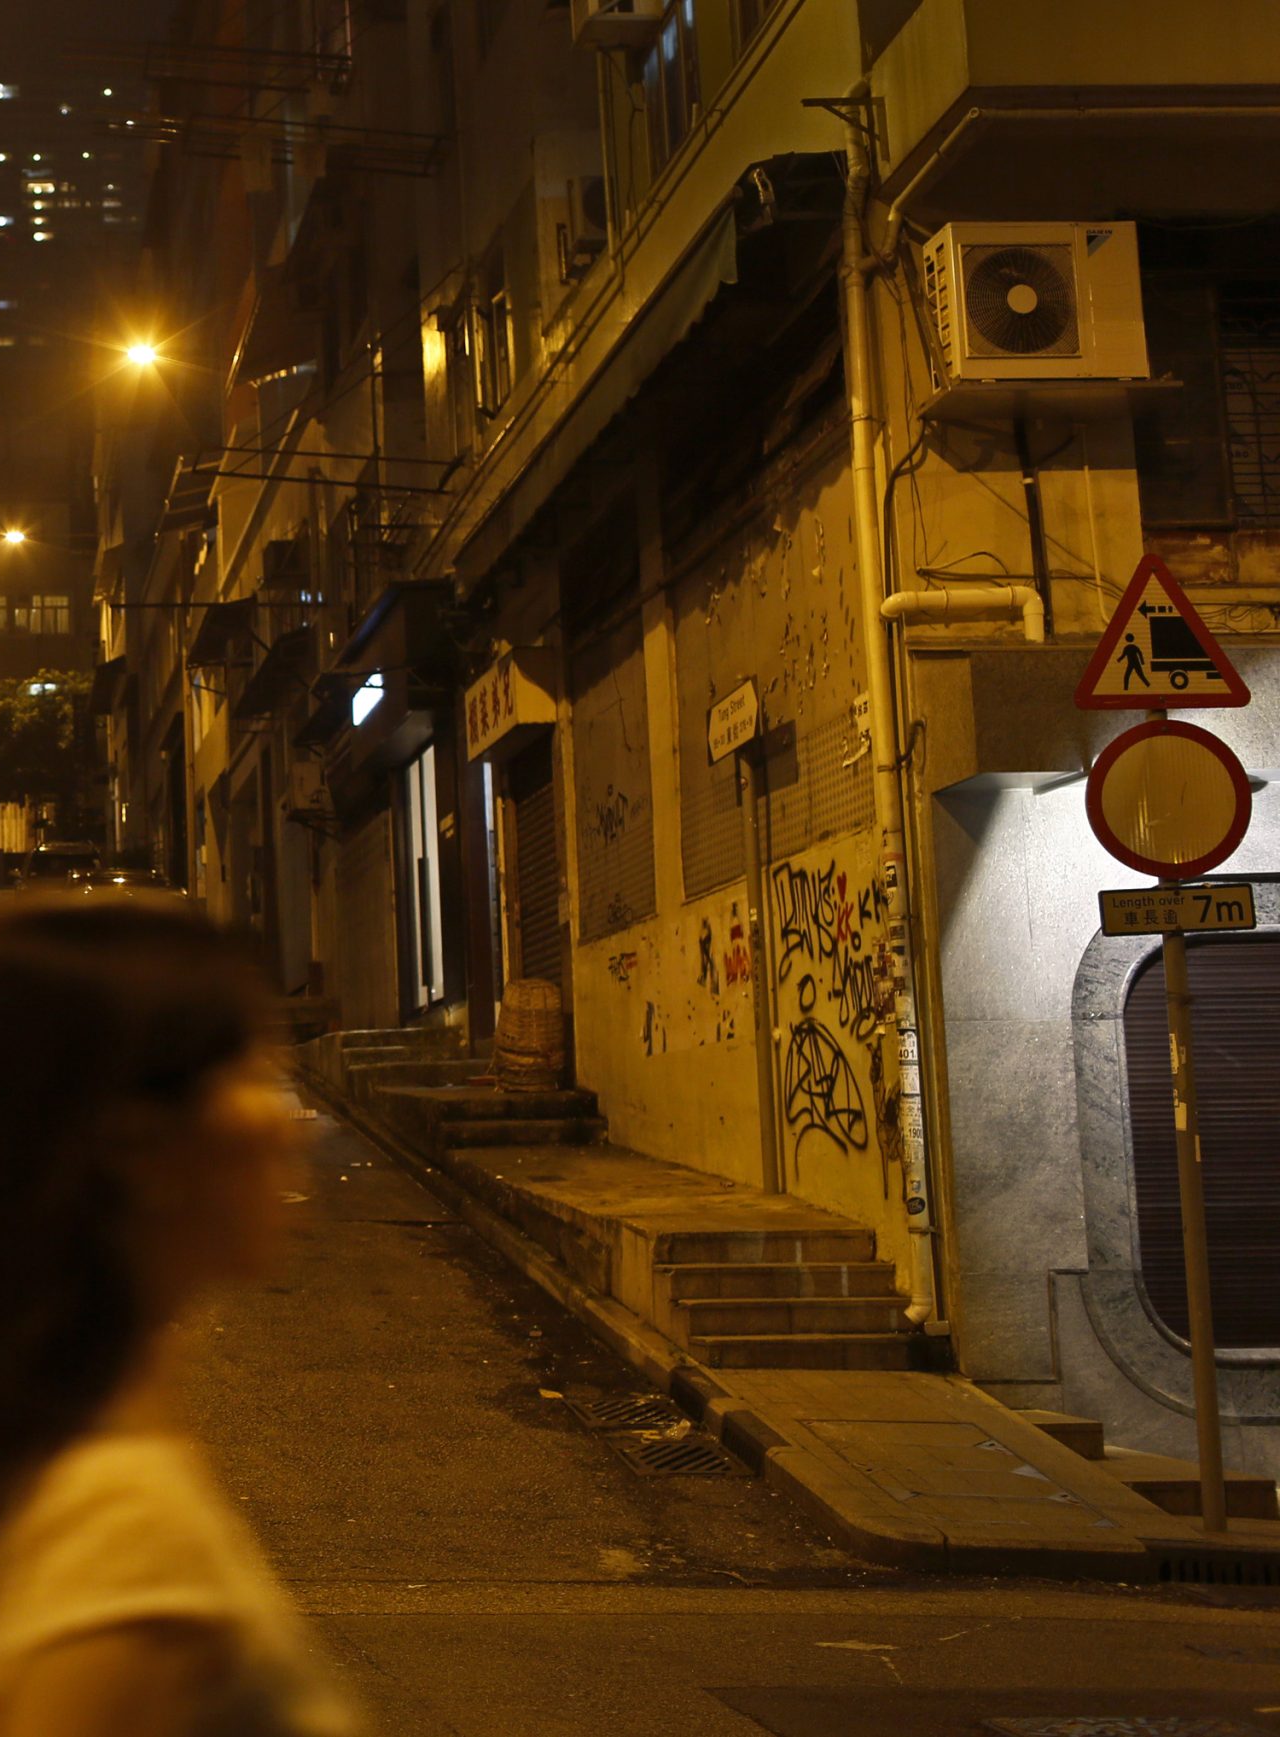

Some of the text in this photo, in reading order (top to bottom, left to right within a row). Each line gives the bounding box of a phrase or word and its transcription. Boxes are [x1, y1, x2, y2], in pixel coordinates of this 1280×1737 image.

[1112, 895, 1185, 909] Length over
[1192, 894, 1244, 924] 7m
[1124, 908, 1179, 927] 車長逾
